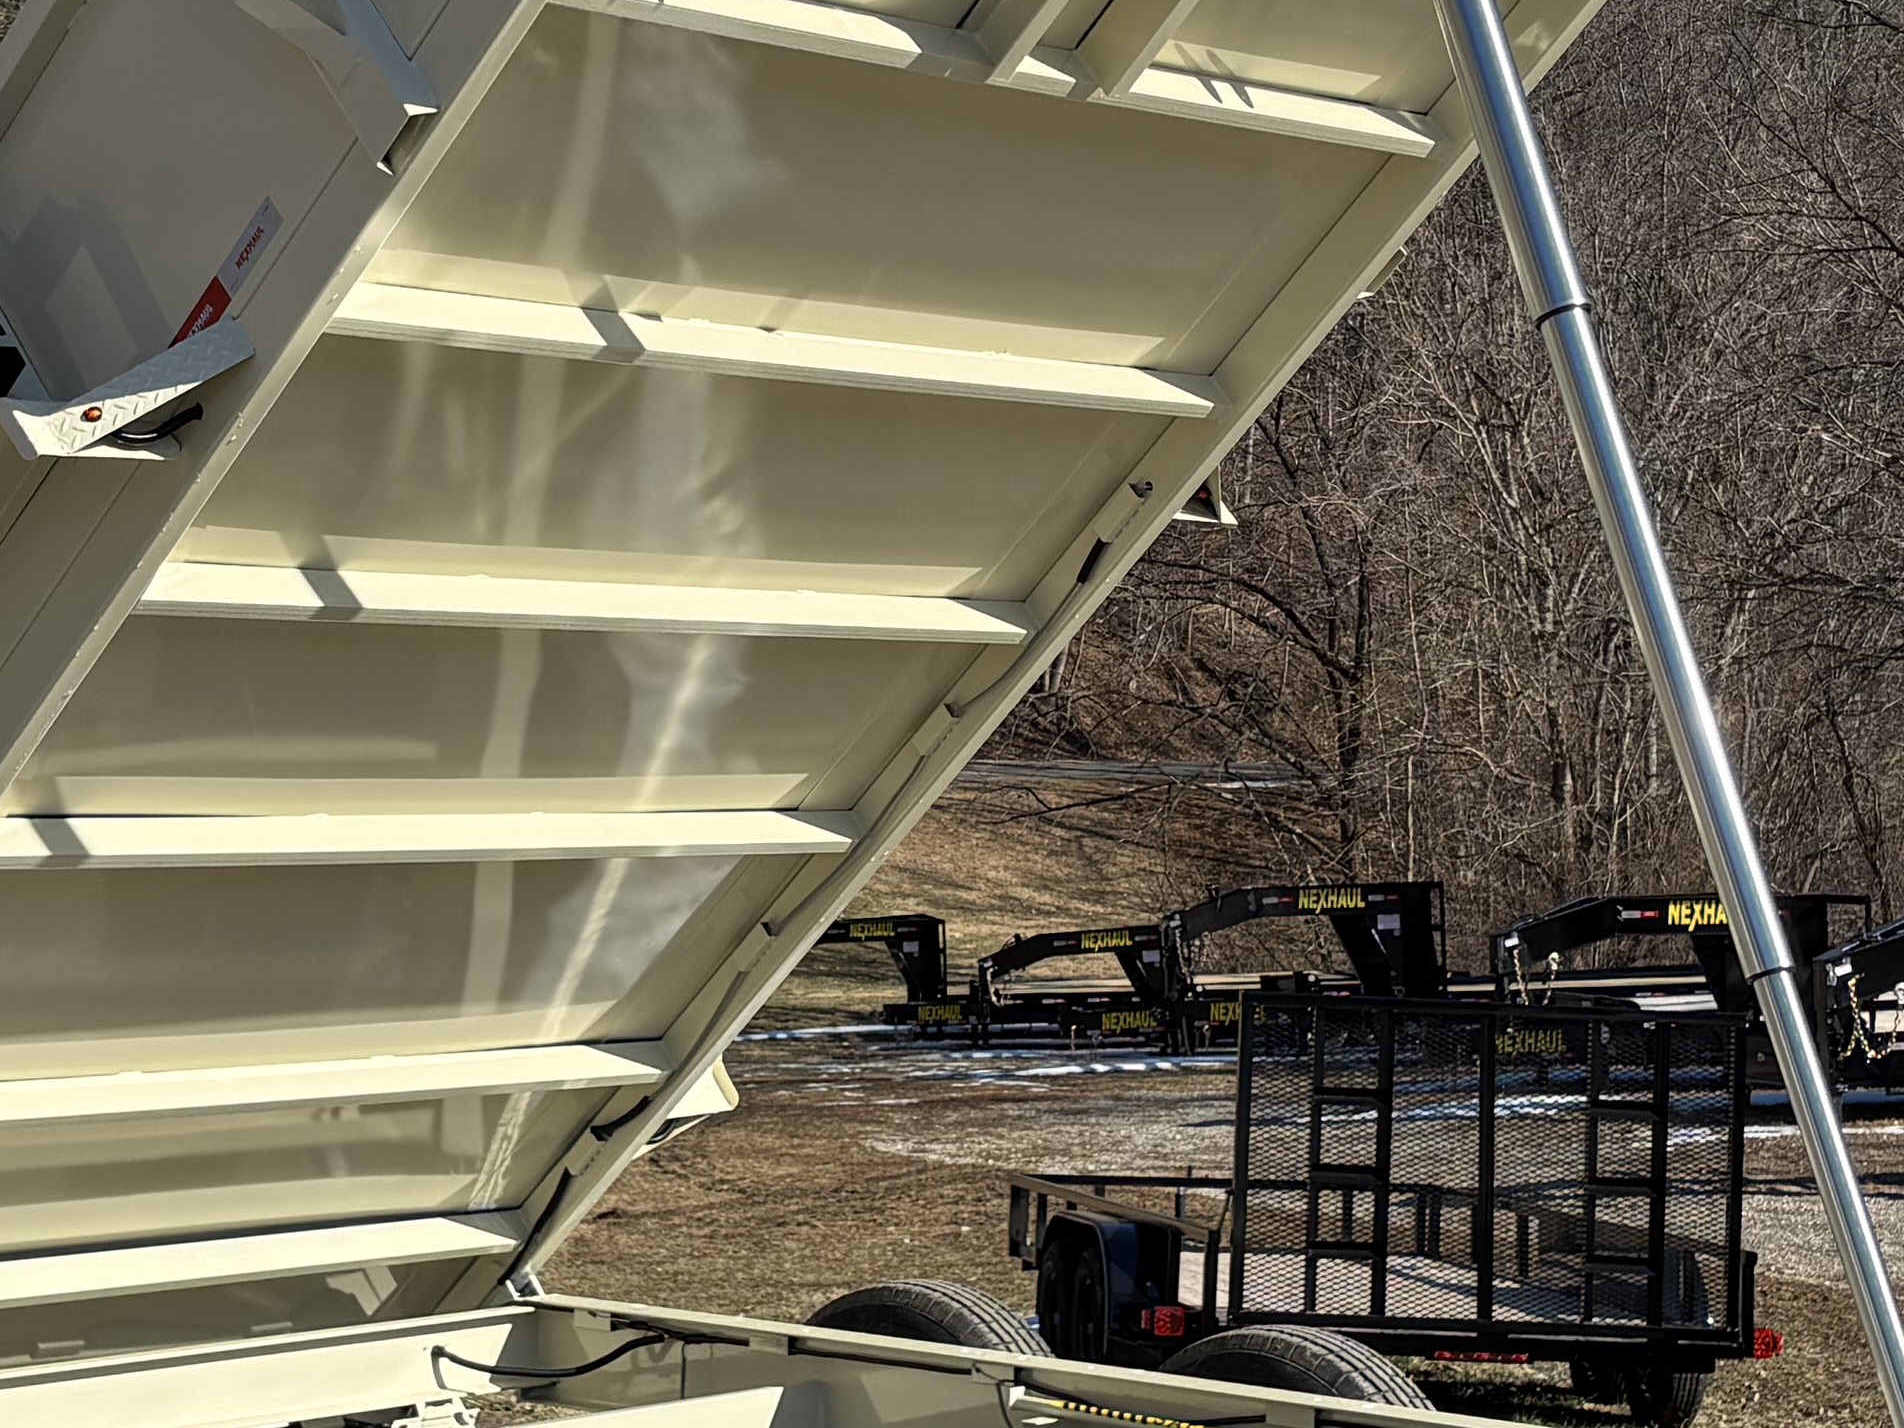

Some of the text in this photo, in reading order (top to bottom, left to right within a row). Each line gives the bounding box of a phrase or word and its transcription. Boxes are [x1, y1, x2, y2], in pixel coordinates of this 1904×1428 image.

[1298, 887, 1366, 914] NEXHAUL
[1667, 899, 1728, 932] NEXHA
[849, 921, 895, 941] NEXHAUL
[1080, 930, 1133, 952] NEXHAUL
[1101, 1010, 1158, 1034] NEXHAUL
